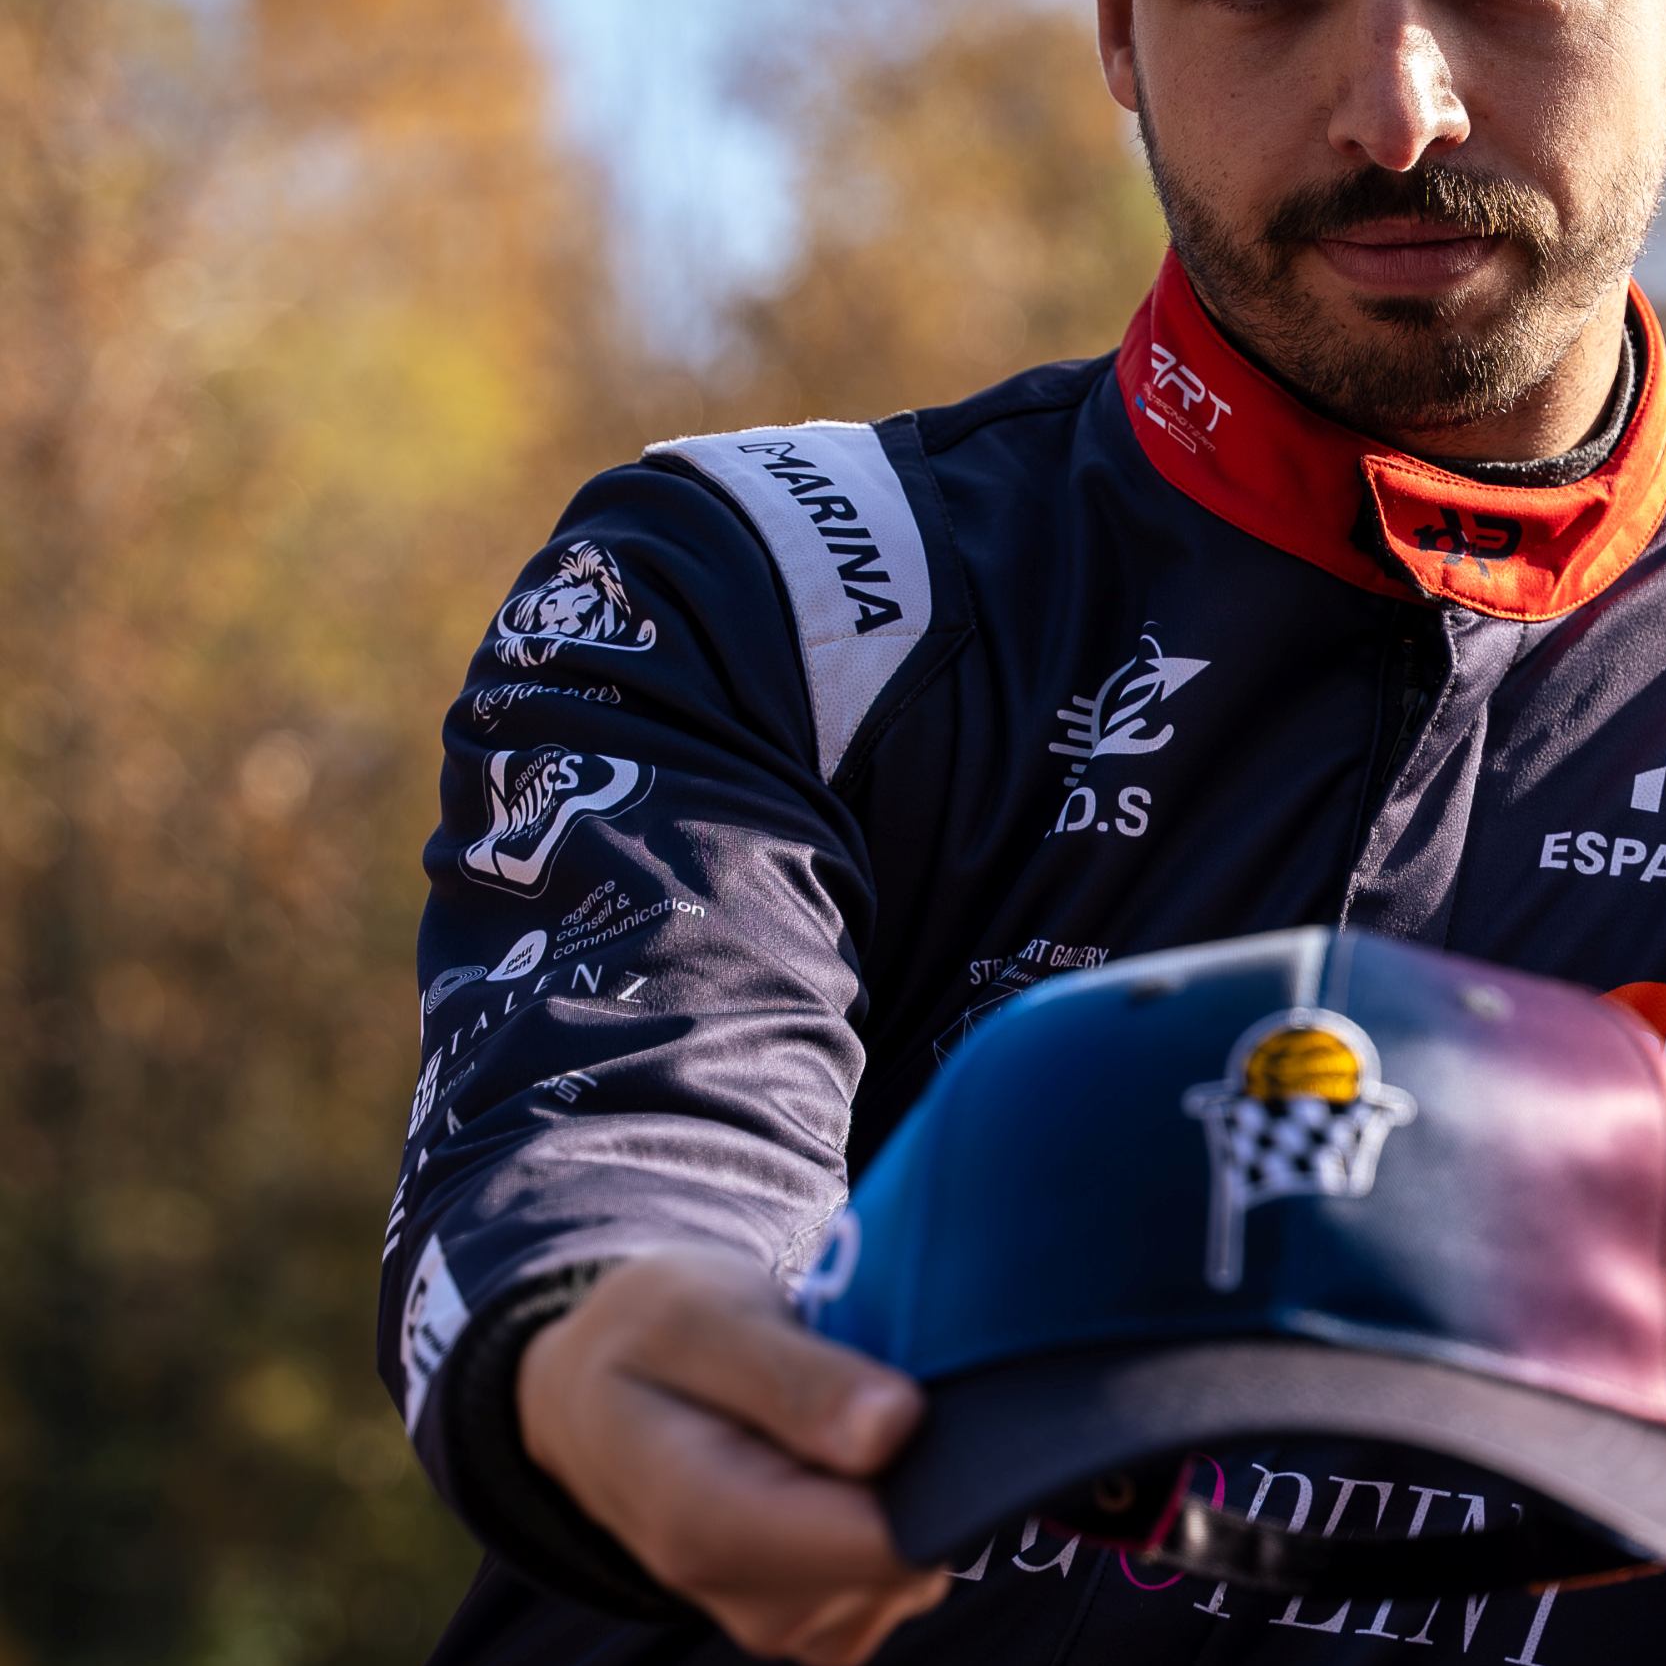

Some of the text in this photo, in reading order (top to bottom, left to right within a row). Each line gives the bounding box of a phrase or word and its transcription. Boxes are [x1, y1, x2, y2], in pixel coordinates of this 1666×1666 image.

[737, 441, 904, 635] MARINA
[514, 750, 562, 792] GROUPE
[556, 893, 632, 942] conseil &
[561, 880, 616, 927] agence
[552, 897, 706, 961] communication
[506, 942, 535, 970] pour
[450, 963, 649, 1056] TALENZ
